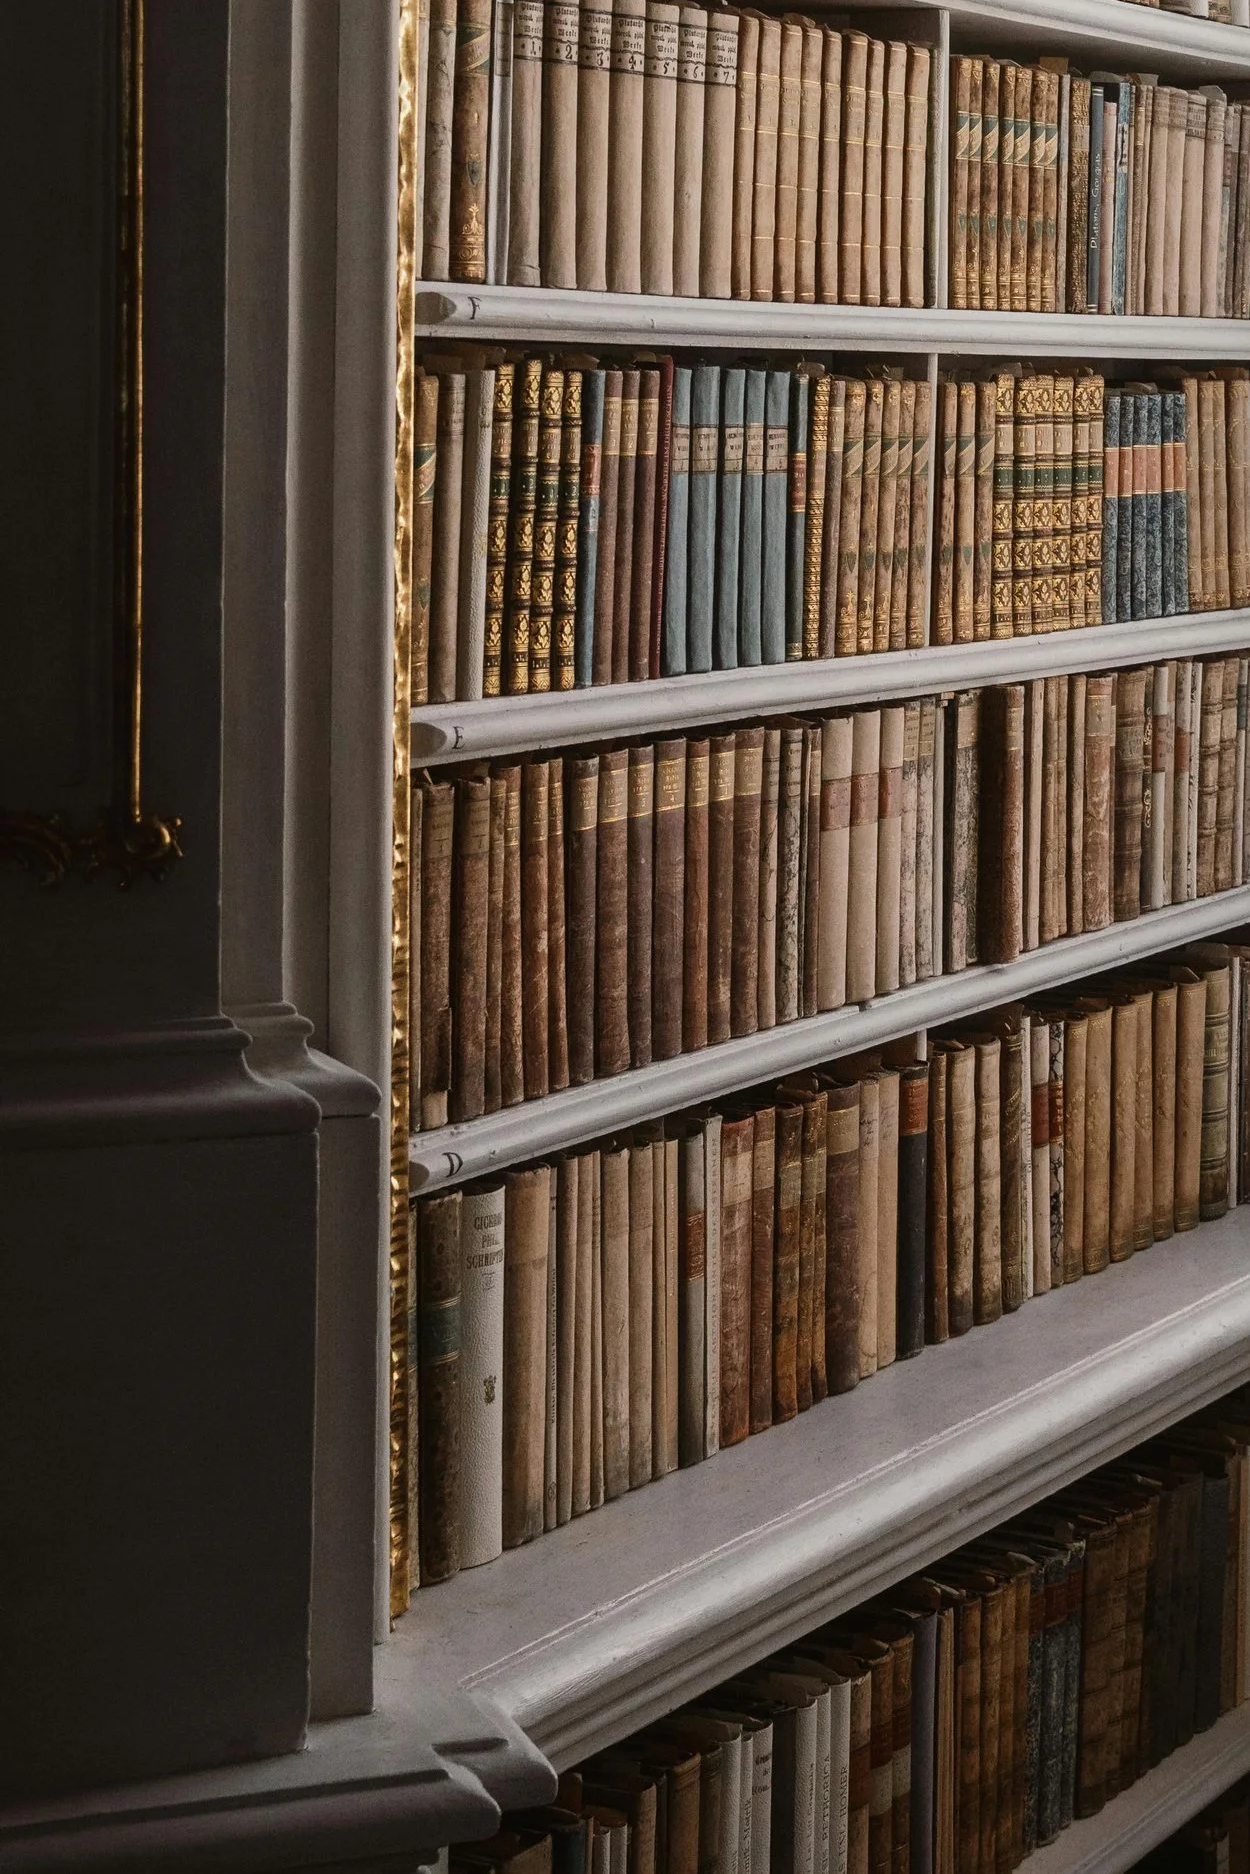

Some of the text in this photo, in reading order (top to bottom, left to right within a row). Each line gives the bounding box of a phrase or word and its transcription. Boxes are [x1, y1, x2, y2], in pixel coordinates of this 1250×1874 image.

[530, 40, 537, 55] 1
[565, 44, 573, 60] 2
[596, 52, 604, 66] 3
[628, 55, 637, 70] 4
[663, 61, 670, 74] 5
[693, 66, 699, 79] 6
[723, 71, 730, 84] 7
[468, 296, 482, 320] F
[664, 383, 672, 445] DEUTSCHEN
[452, 726, 465, 749] E
[441, 1152, 463, 1178] D
[839, 1764, 848, 1819] HOMER
